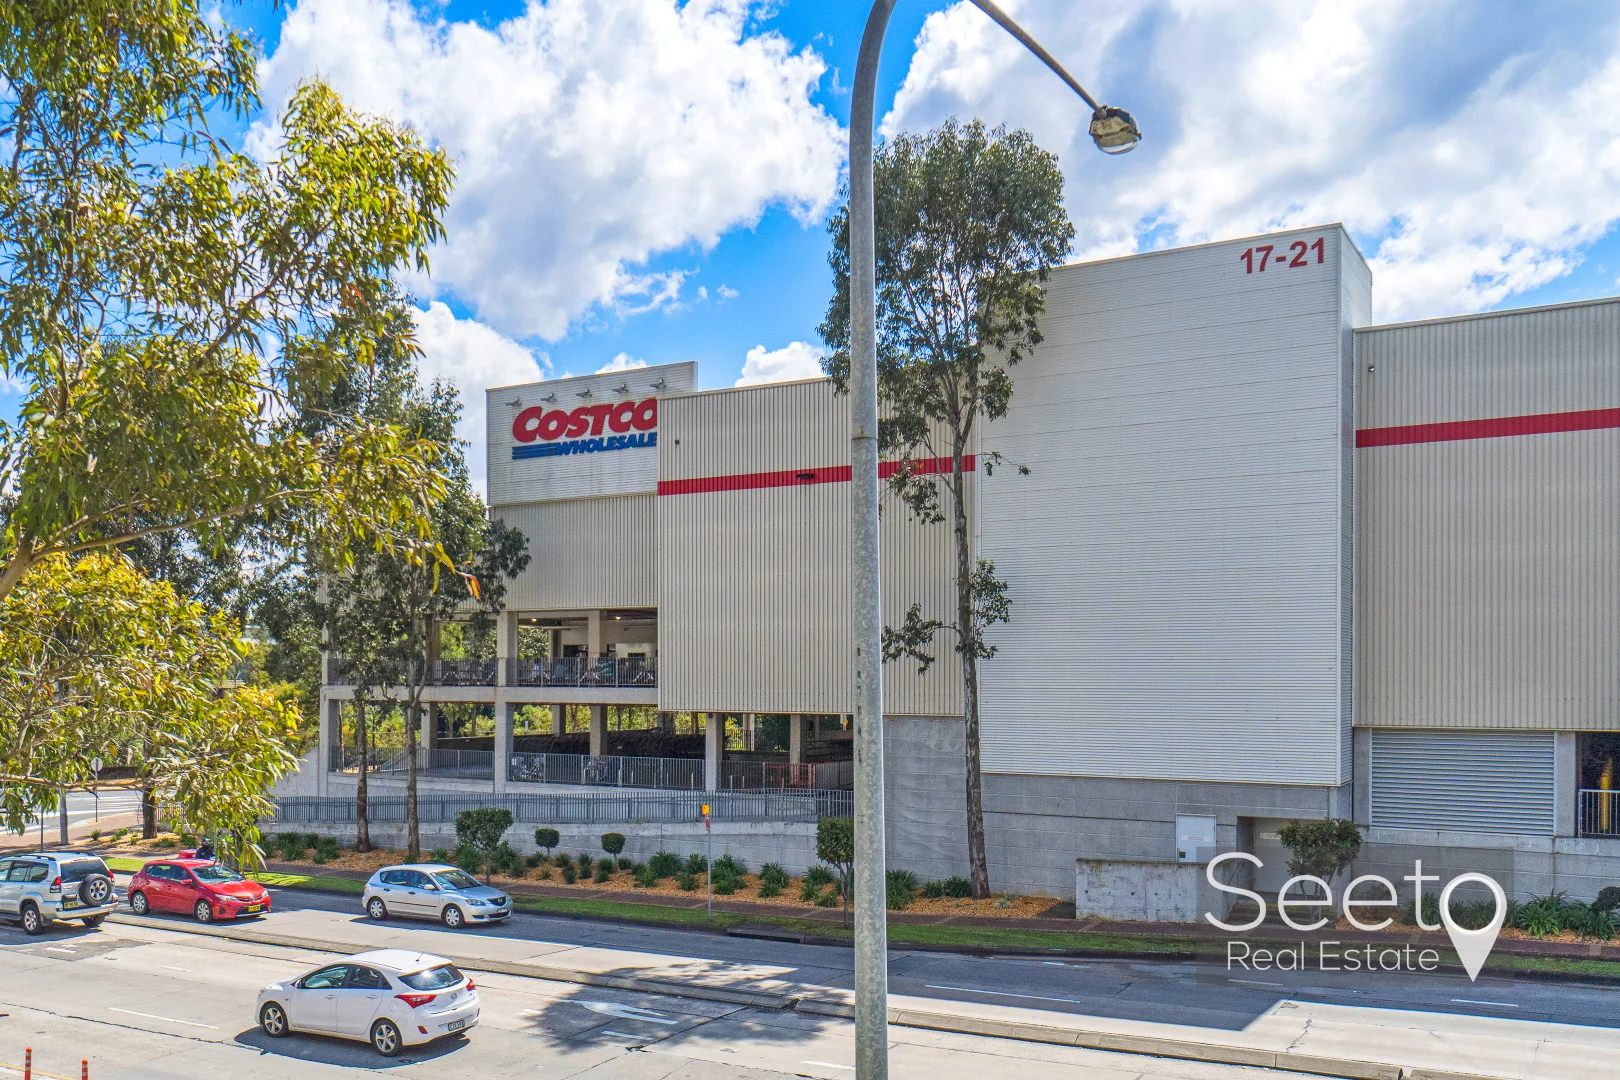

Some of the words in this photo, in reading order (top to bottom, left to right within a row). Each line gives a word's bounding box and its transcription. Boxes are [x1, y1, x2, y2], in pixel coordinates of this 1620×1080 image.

[1240, 237, 1324, 274] 17-21
[512, 397, 658, 442] COSTCO
[556, 432, 658, 456] WHOLESALE
